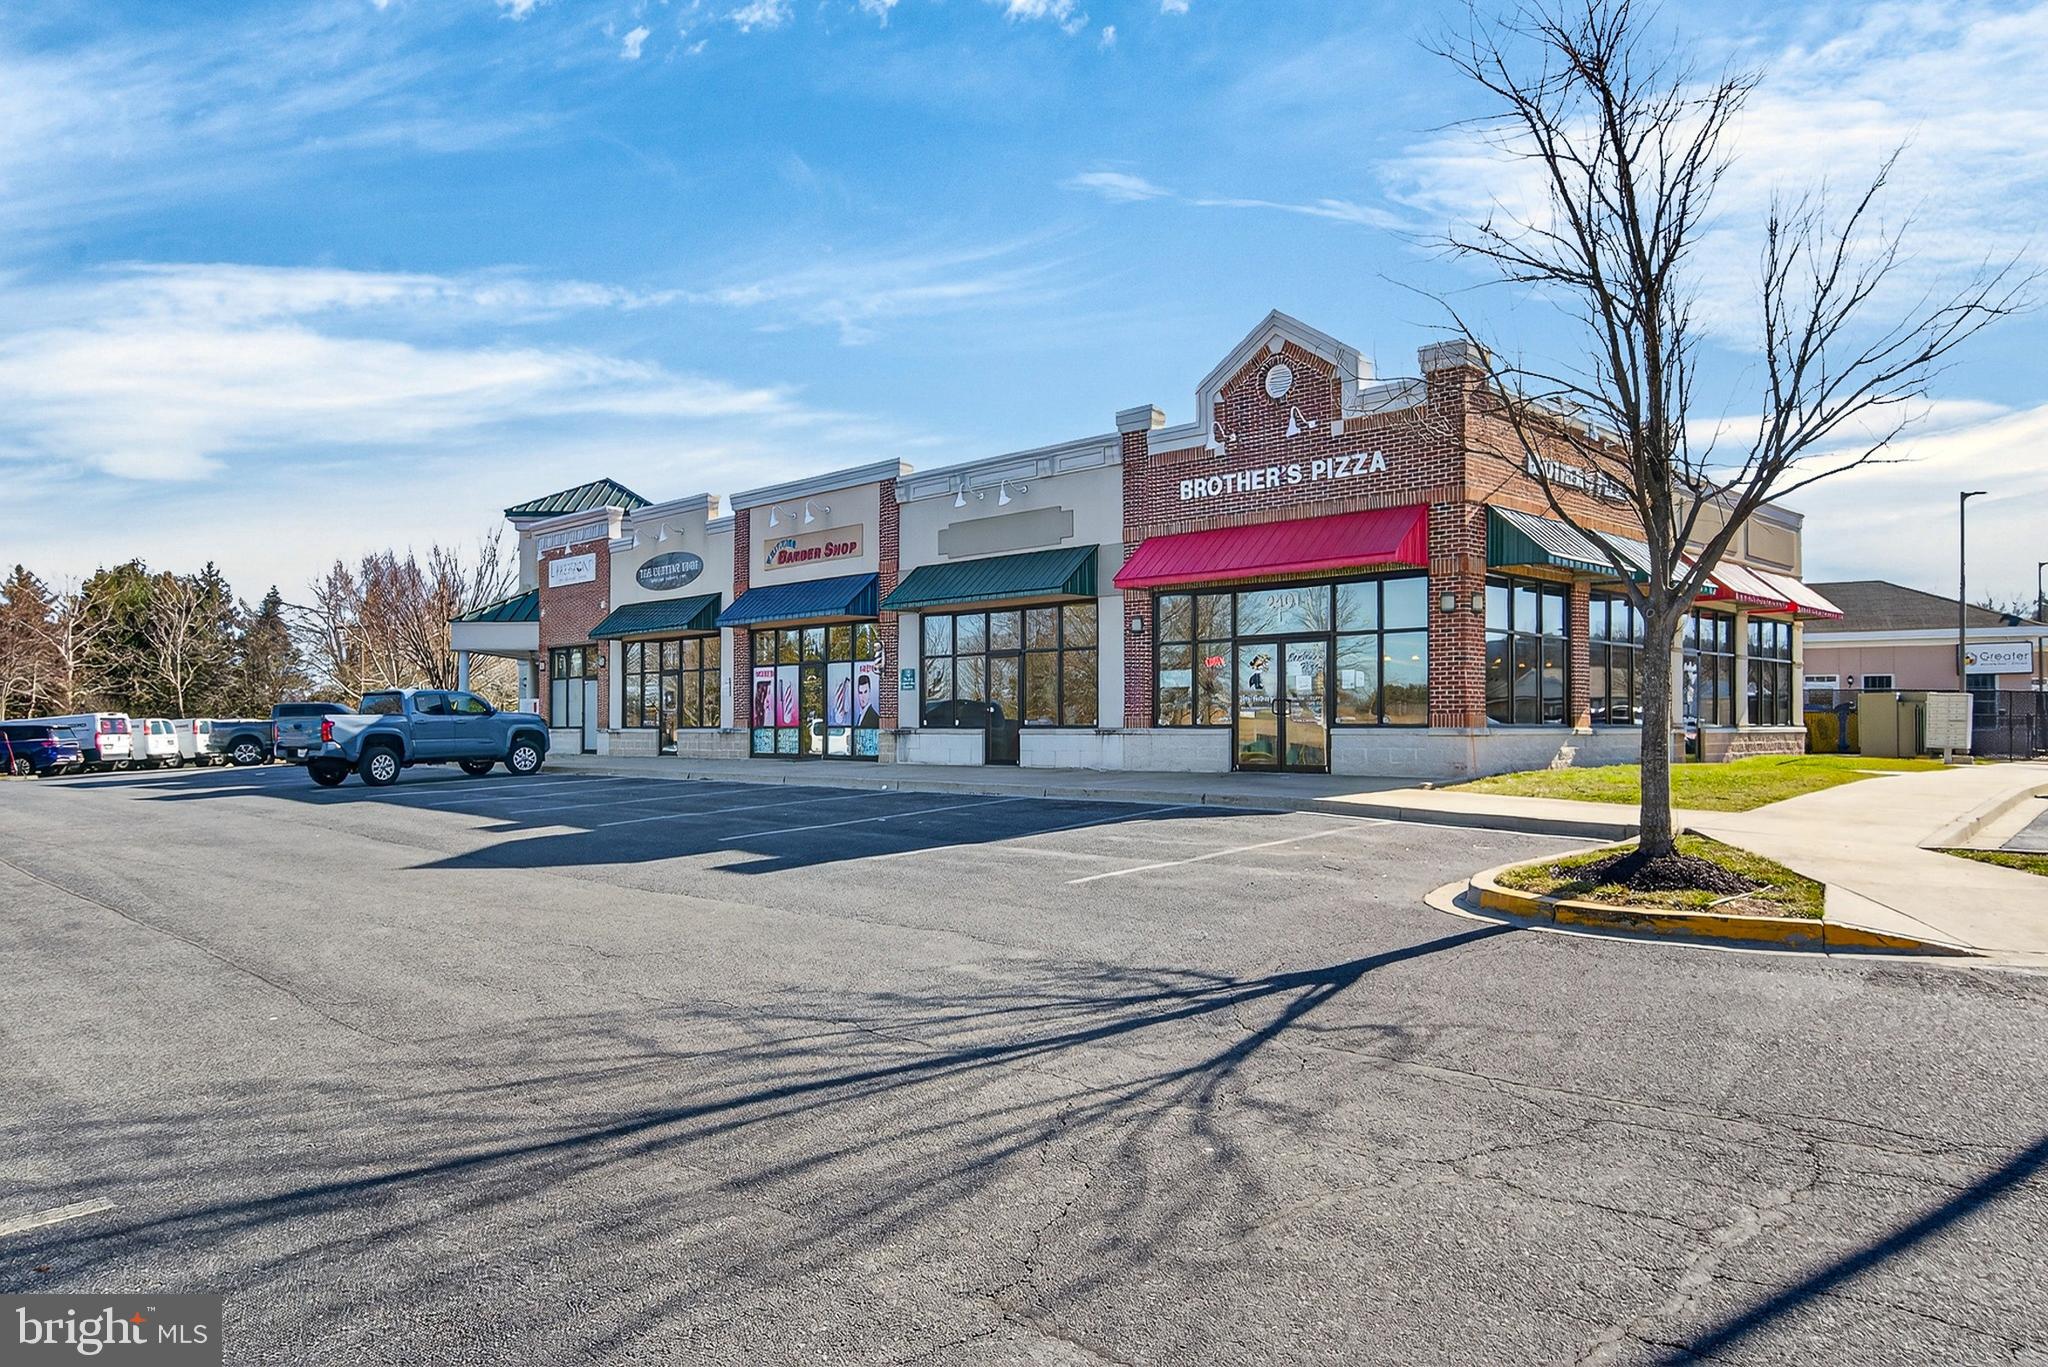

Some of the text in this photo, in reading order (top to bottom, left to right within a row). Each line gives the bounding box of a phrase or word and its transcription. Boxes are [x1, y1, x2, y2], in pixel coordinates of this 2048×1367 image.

[1180, 451, 1387, 500] BROTHER'S PIZZA
[777, 547, 823, 565] BARBER
[824, 541, 858, 558] SHOP
[1980, 652, 2030, 663] Greater
